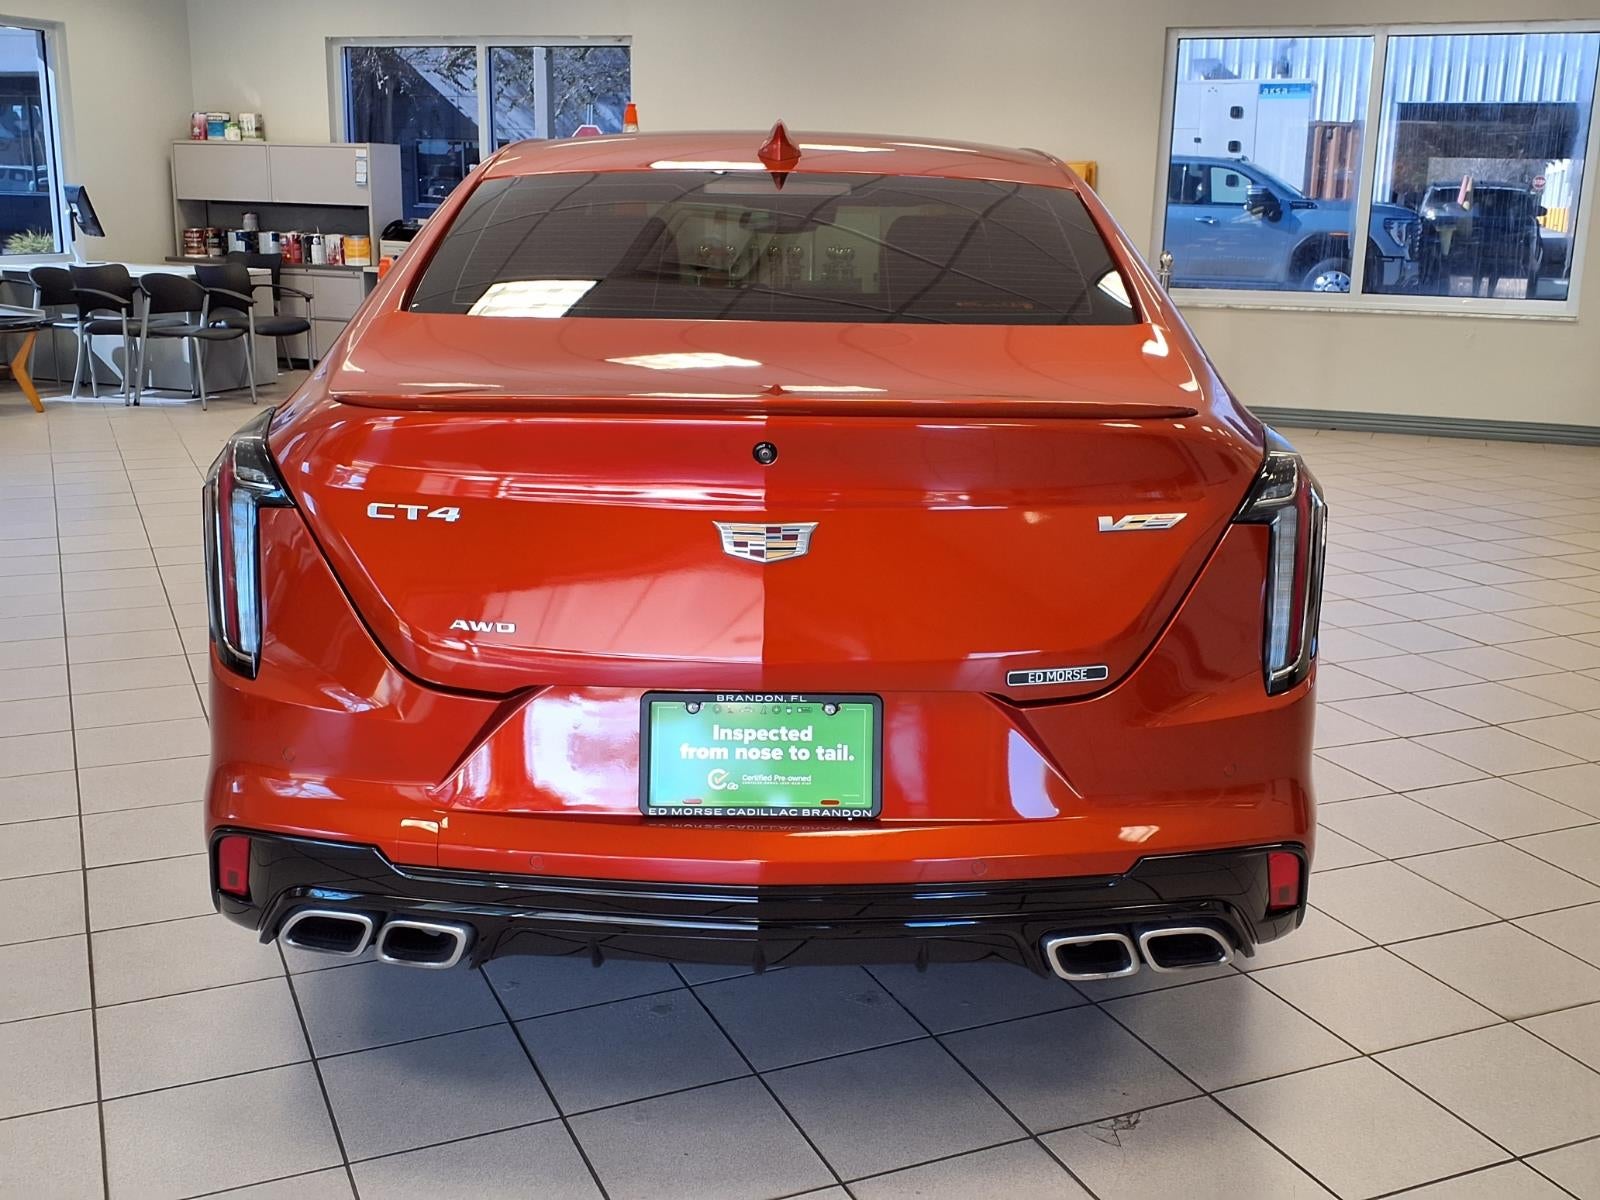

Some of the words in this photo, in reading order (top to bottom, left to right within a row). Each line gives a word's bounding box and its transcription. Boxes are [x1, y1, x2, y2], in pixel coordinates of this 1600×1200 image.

[367, 502, 460, 522] CT4
[449, 619, 516, 633] AWD
[1028, 672, 1043, 684] ED
[1046, 668, 1088, 682] MORSE
[713, 724, 813, 744] Inspected
[680, 743, 729, 761] from
[735, 747, 784, 761] nose
[789, 746, 810, 761] to
[816, 743, 855, 762] tail.
[742, 774, 773, 782] Certified
[648, 807, 667, 816] ED
[671, 808, 722, 816] MORSE
[726, 808, 799, 817] CADILLAC
[802, 808, 873, 818] BRANDON
